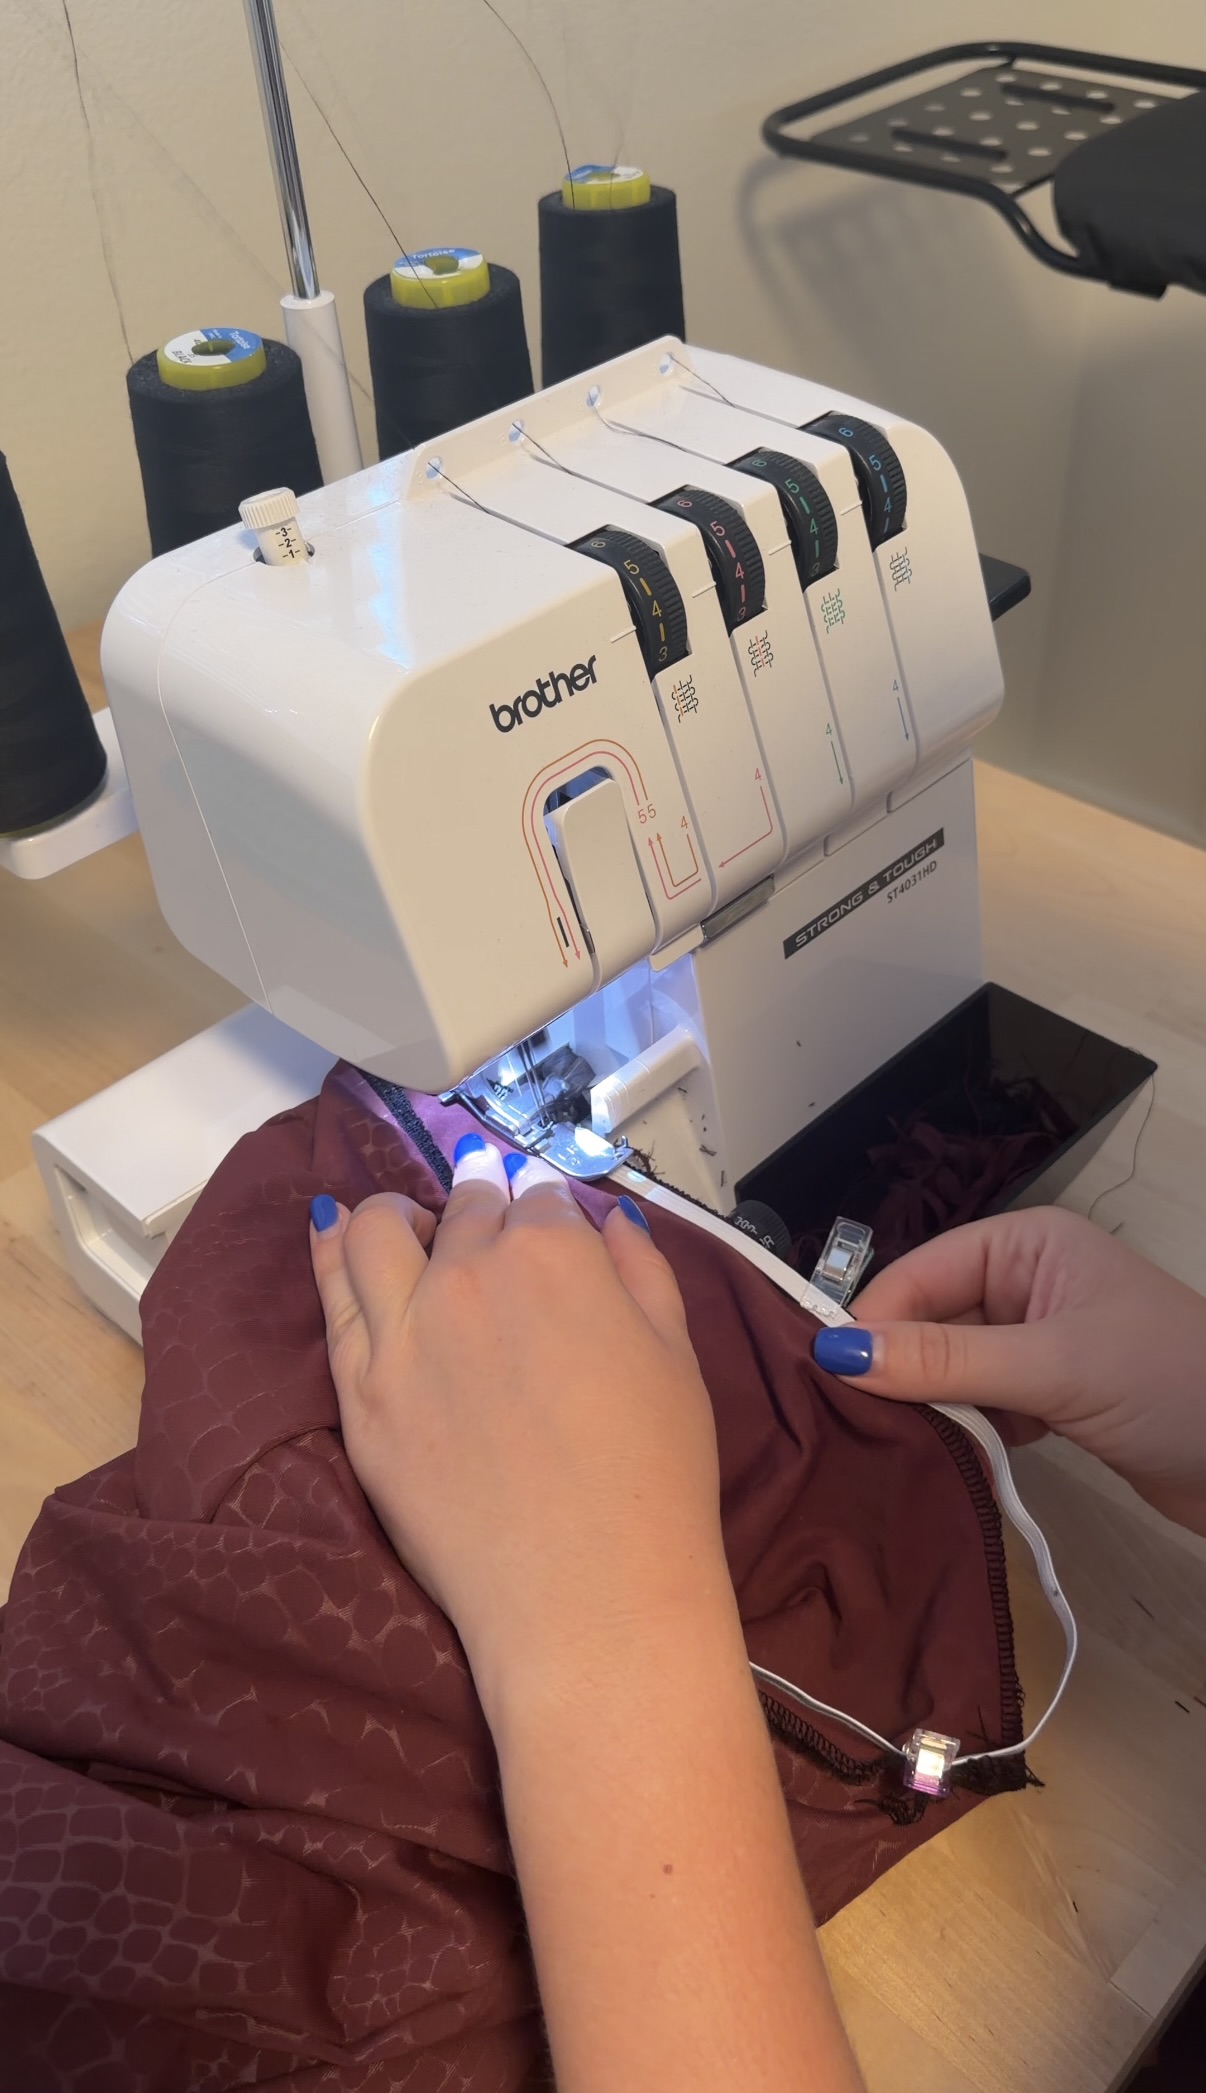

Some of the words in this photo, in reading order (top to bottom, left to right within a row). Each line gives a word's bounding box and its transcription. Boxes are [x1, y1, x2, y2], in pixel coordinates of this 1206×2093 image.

[838, 427, 854, 438] 6
[868, 454, 882, 471] 5
[883, 496, 892, 513] 4
[784, 478, 800, 494] 5
[809, 518, 819, 535] 4
[709, 520, 726, 537] 5
[735, 562, 745, 579] 4
[623, 559, 640, 575] 5
[652, 600, 663, 618] 4
[659, 646, 668, 662] 3
[489, 654, 598, 733] brother
[892, 679, 899, 692] 4
[825, 722, 833, 735] 4
[754, 767, 762, 781] 4
[680, 815, 689, 829] 4
[795, 891, 864, 948] STRONG
[868, 881, 881, 895] &
[882, 838, 937, 883] TOUGH
[887, 860, 937, 904] ST4031HD
